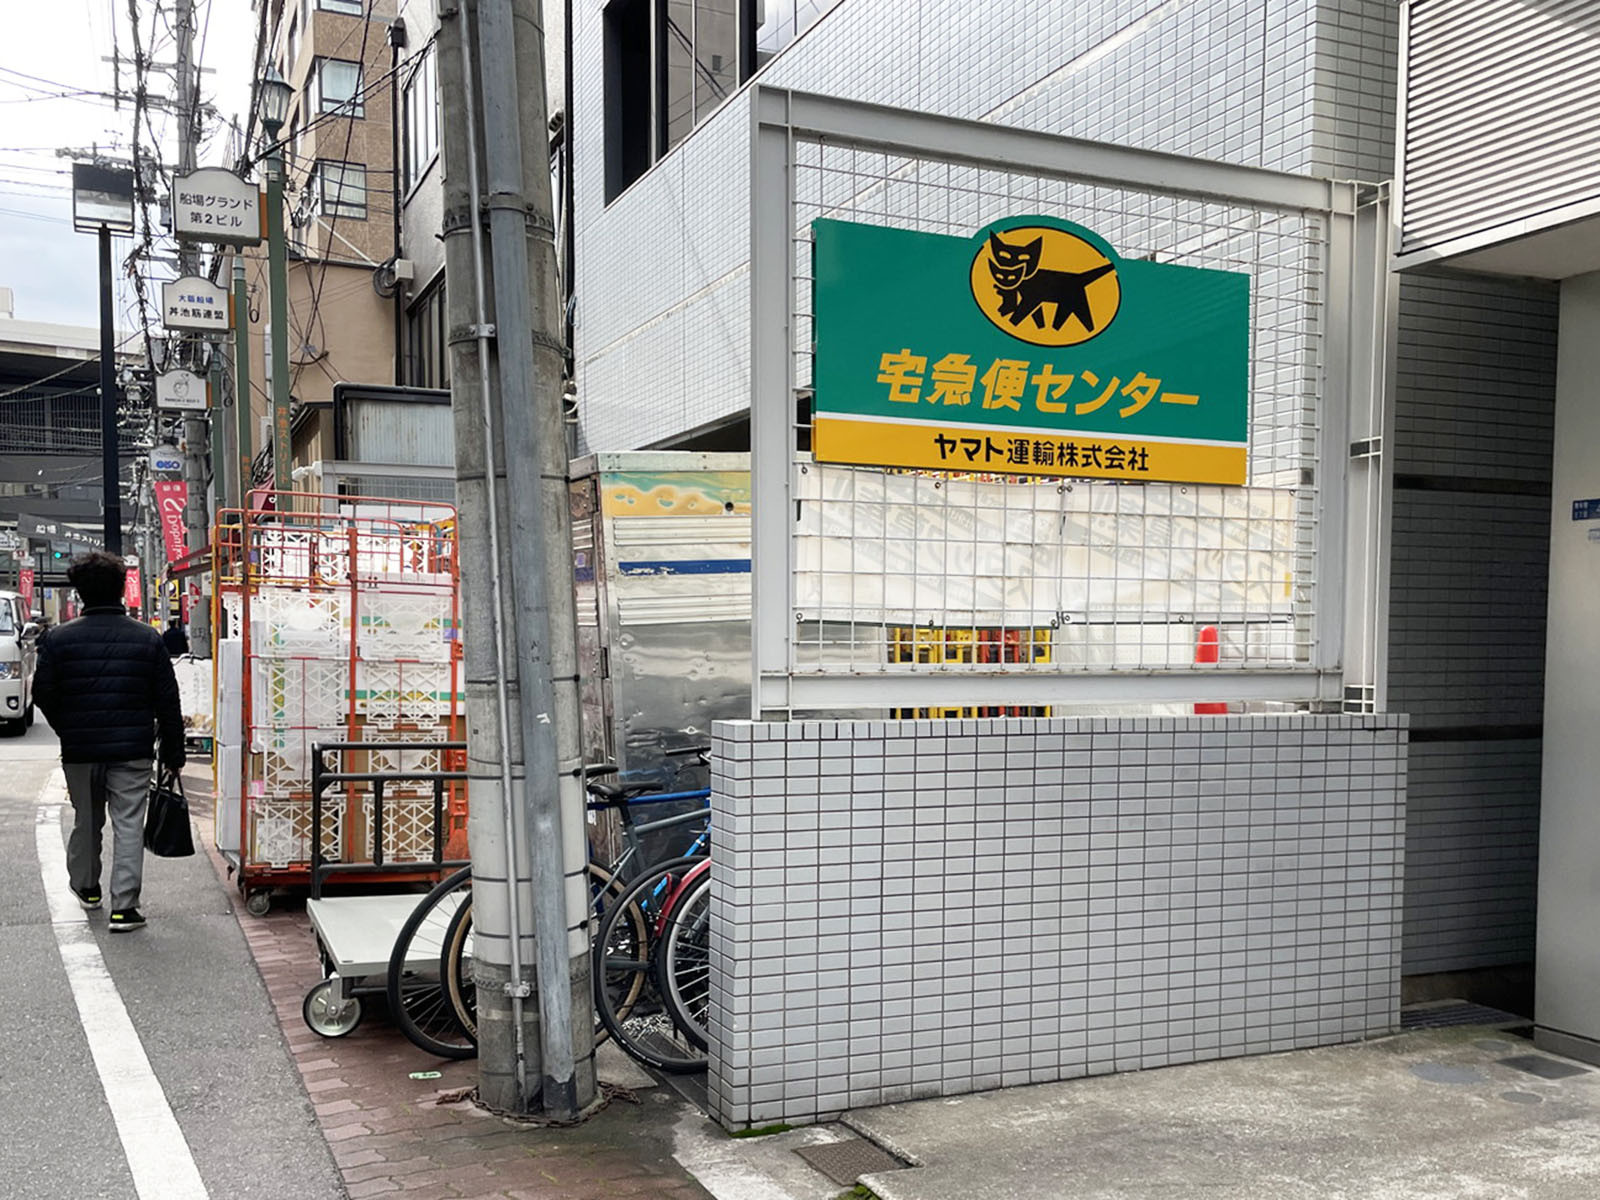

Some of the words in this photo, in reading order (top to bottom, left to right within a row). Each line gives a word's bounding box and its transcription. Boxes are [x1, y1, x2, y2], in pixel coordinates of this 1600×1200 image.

[179, 192, 253, 210] 船場グランド
[190, 211, 243, 227] 第2ビル
[876, 348, 1200, 419] 宅急便センター
[933, 432, 1150, 472] ヤマト運輸株式会社
